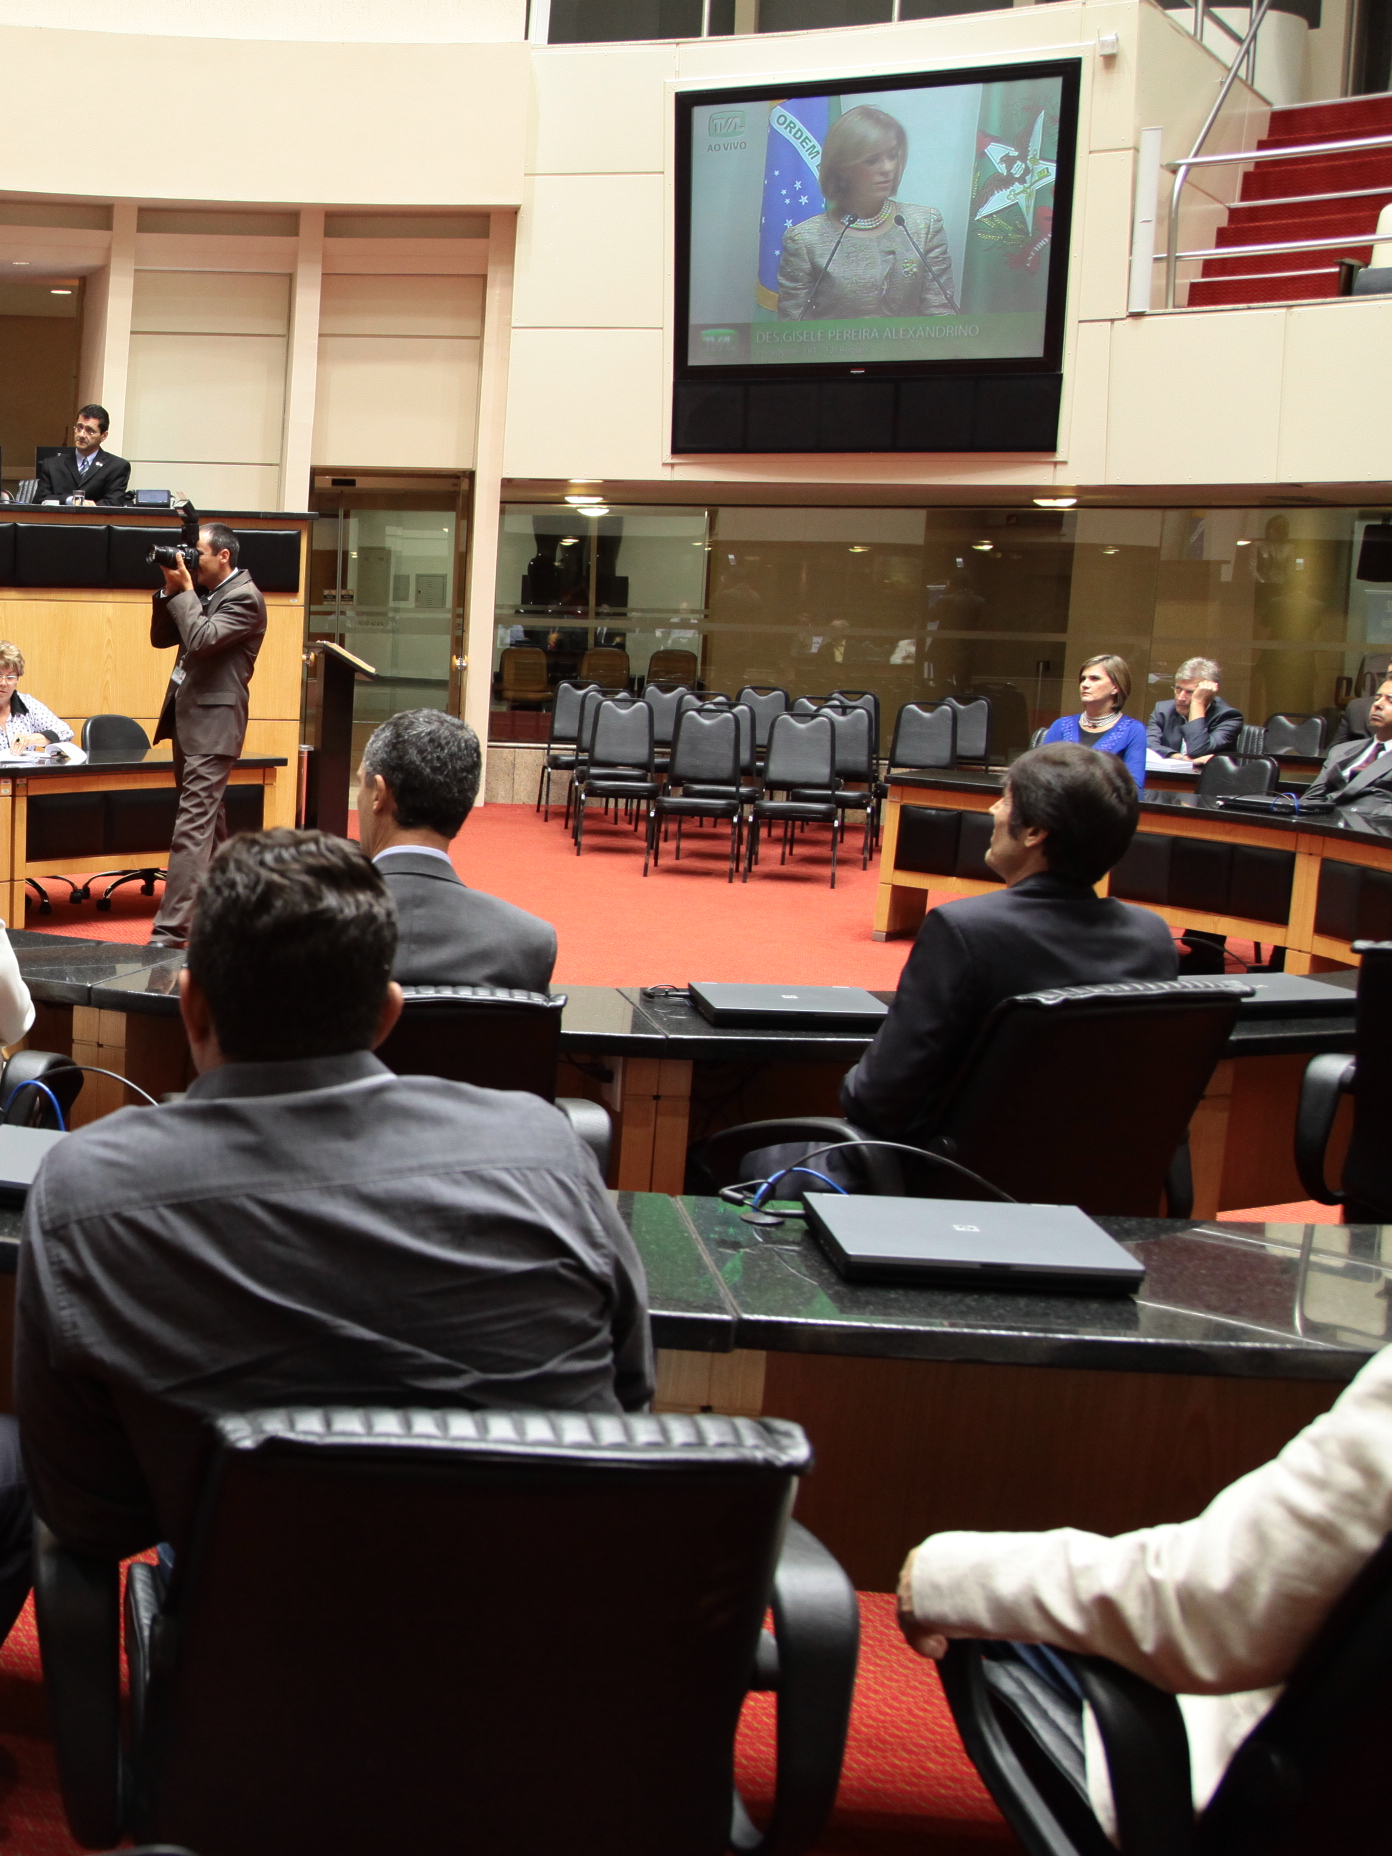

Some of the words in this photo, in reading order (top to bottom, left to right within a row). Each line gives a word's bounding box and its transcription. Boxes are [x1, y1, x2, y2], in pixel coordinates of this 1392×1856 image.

[707, 143, 721, 153] AO
[723, 141, 747, 151] VIVO
[776, 113, 821, 161] ORDEM
[756, 330, 824, 344] DES.GISELE
[828, 328, 879, 341] PEREIRA
[883, 324, 979, 340] ALEXANDRINO
